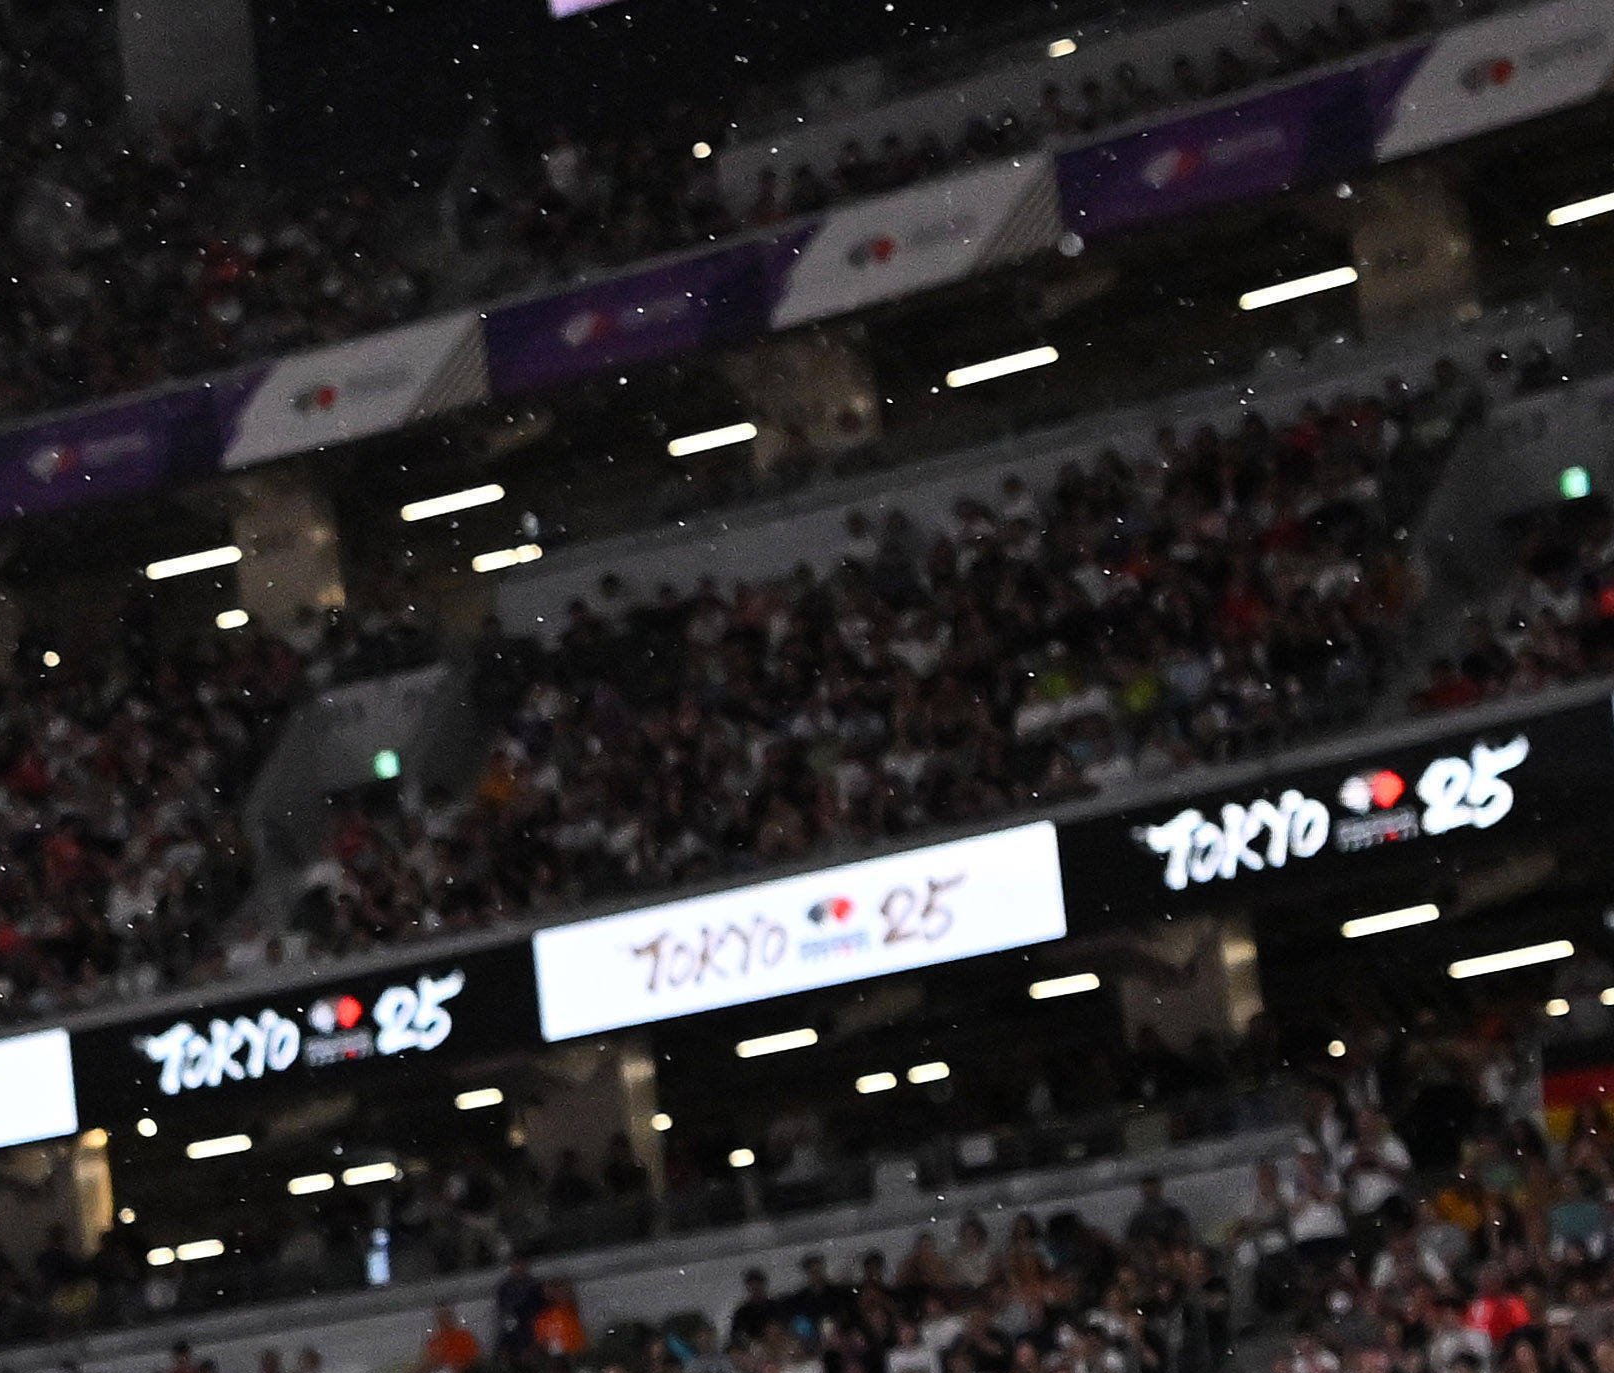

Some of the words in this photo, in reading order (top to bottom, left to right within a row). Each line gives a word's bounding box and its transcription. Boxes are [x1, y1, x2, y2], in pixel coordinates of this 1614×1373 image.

[1133, 787, 1330, 891] TOKYO
[1415, 734, 1530, 835] 25
[622, 913, 787, 995] TOKYO
[877, 873, 968, 947] 25
[136, 1008, 301, 1096] TOKYO
[373, 969, 466, 1055] 25
